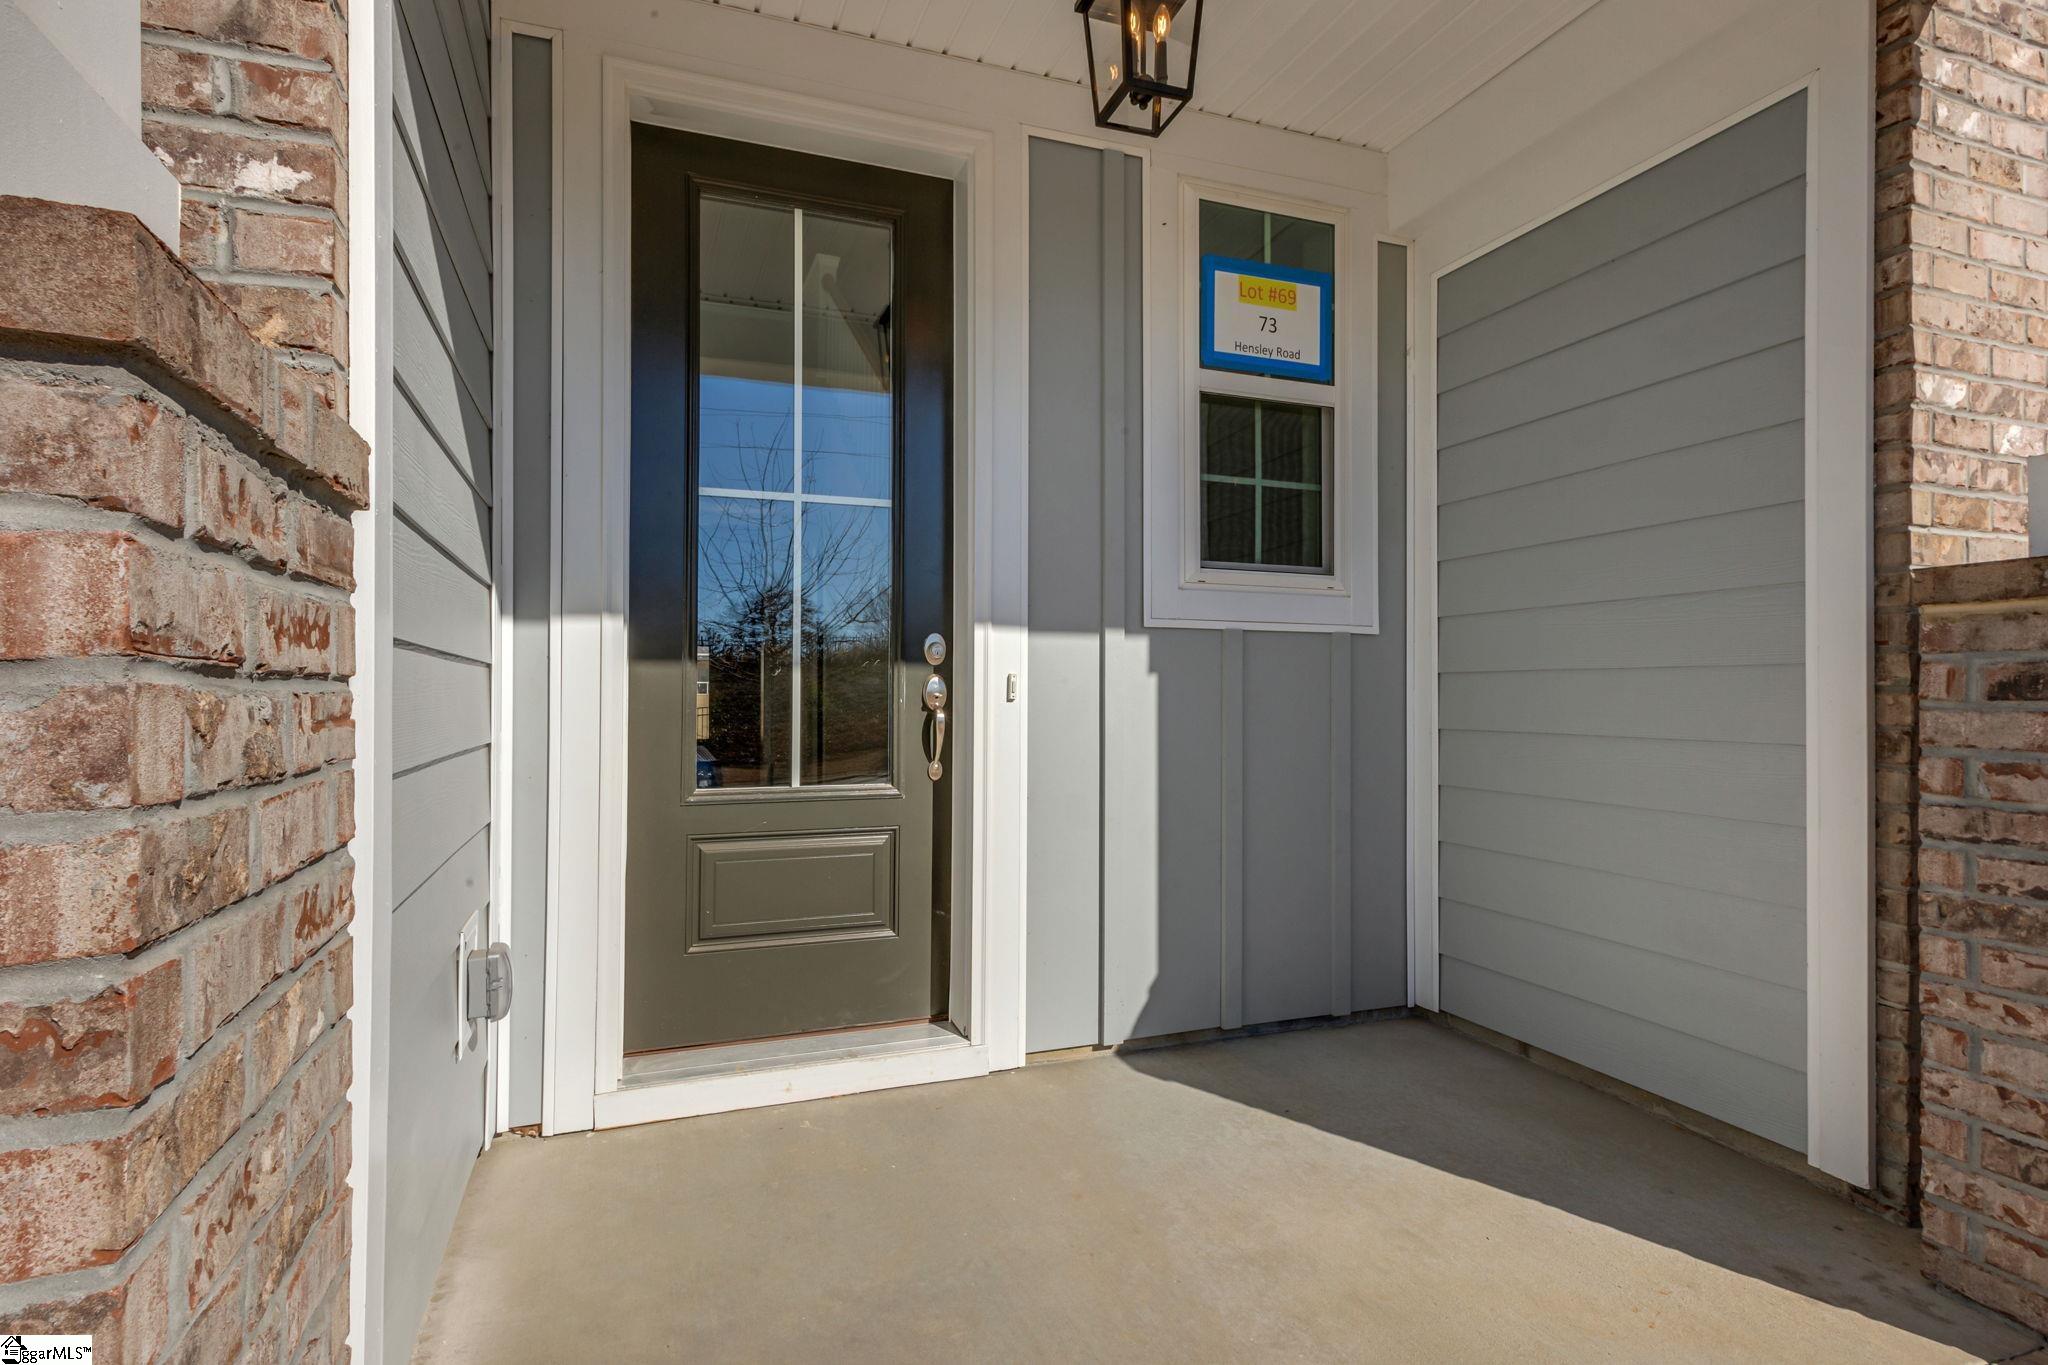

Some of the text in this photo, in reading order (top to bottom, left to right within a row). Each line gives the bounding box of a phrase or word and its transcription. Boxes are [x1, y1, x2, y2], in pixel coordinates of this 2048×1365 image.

[1239, 281, 1297, 305] Lot #69
[1258, 315, 1278, 334] 73
[1234, 340, 1301, 360] Hensley Road
